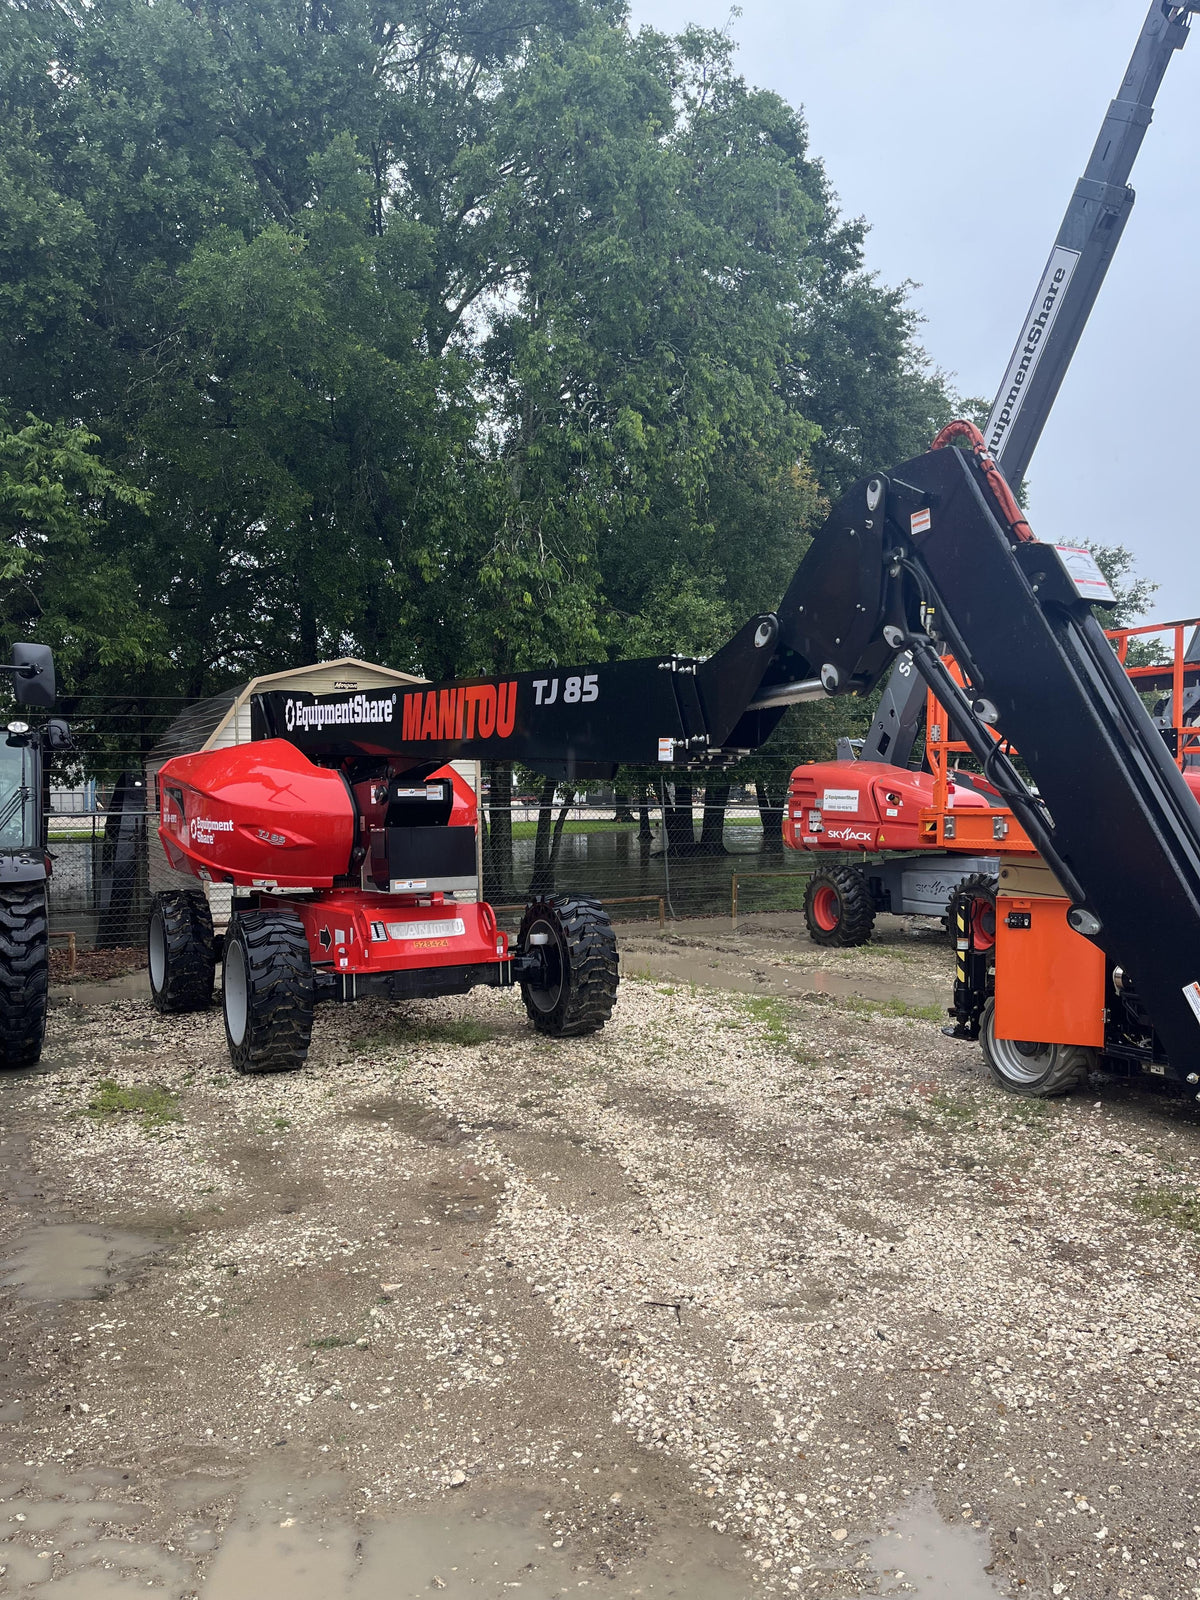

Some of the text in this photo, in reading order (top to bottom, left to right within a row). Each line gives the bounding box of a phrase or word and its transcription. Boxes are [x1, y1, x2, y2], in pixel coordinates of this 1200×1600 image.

[987, 267, 1066, 457] uipmentShare
[532, 674, 599, 705] TJ 85
[402, 681, 518, 741] MANITOU
[197, 817, 234, 832] Equipment
[197, 832, 215, 844] Share
[827, 827, 871, 841] SKYJACK
[390, 921, 463, 938] MANITOU
